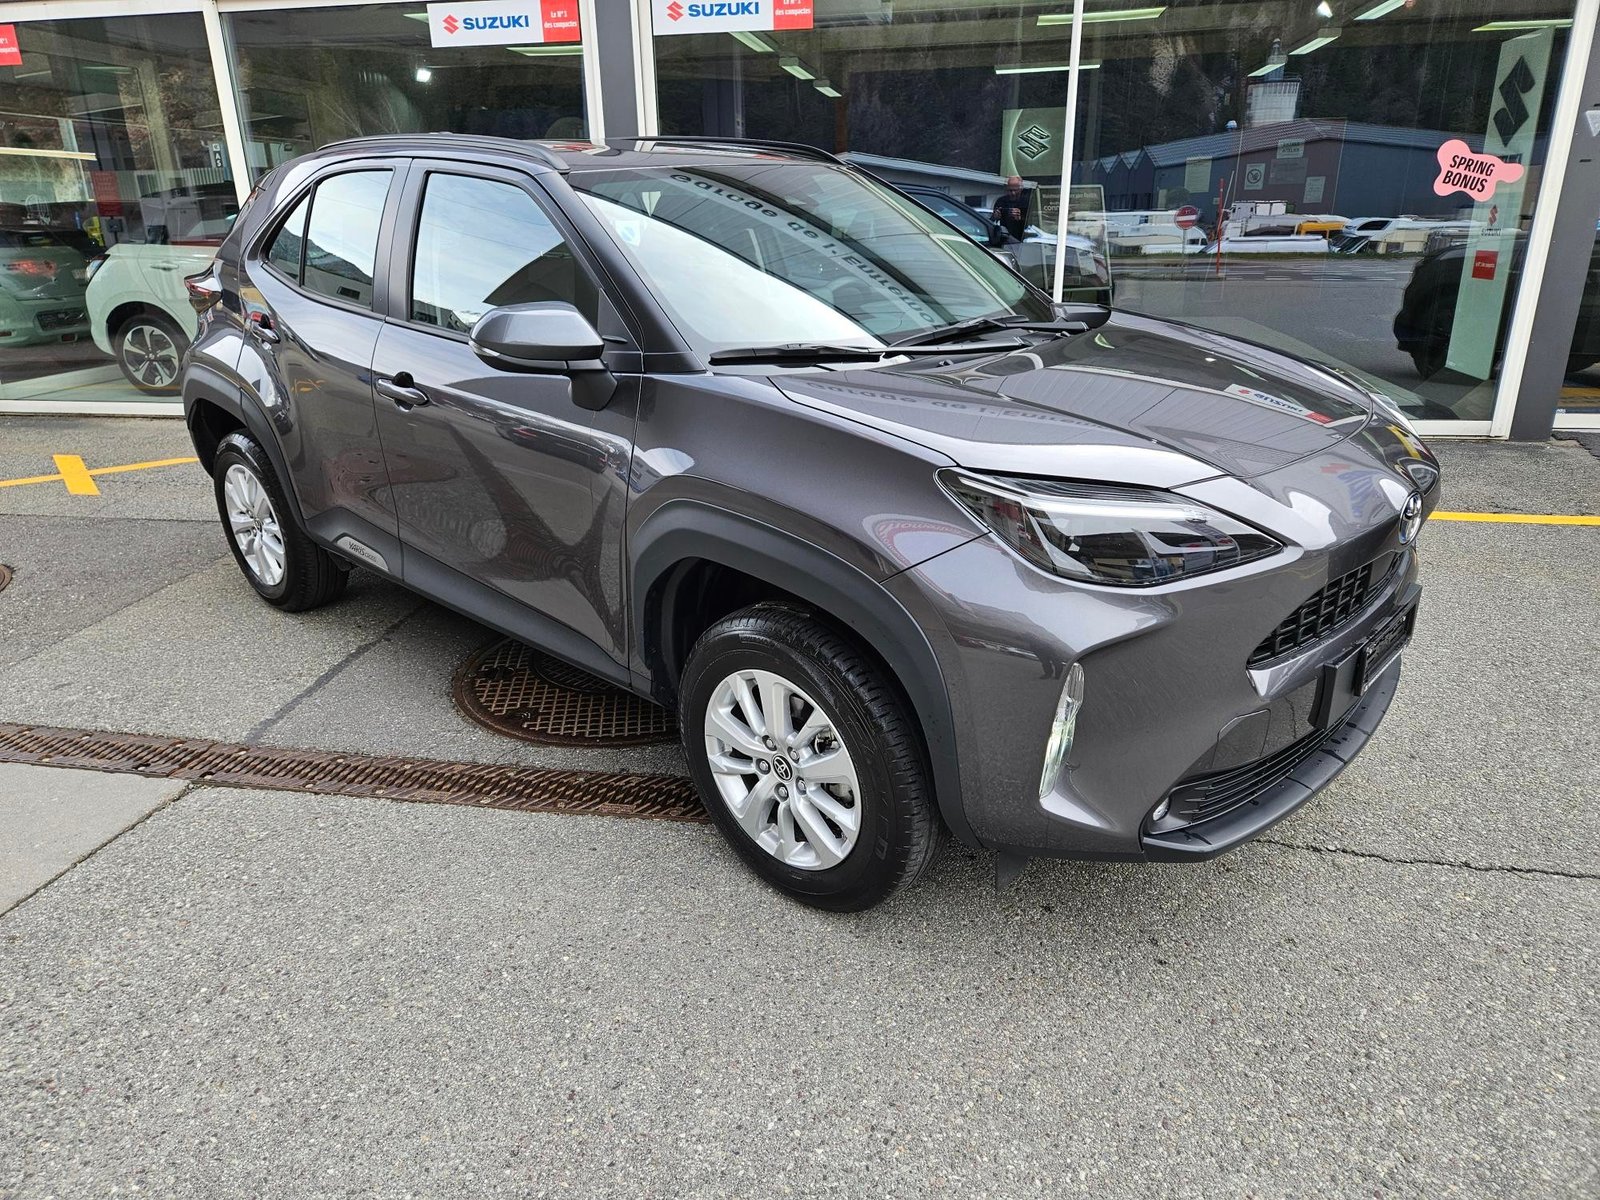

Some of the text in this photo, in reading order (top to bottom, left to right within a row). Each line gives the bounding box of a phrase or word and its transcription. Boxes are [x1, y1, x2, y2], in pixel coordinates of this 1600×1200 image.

[688, 2, 760, 17] SUZUKI
[462, 15, 530, 30] SUZUKI
[544, 21, 553, 29] des
[1449, 154, 1496, 177] SPRING
[1442, 170, 1488, 193] BONUS
[348, 541, 365, 556] YARIS
